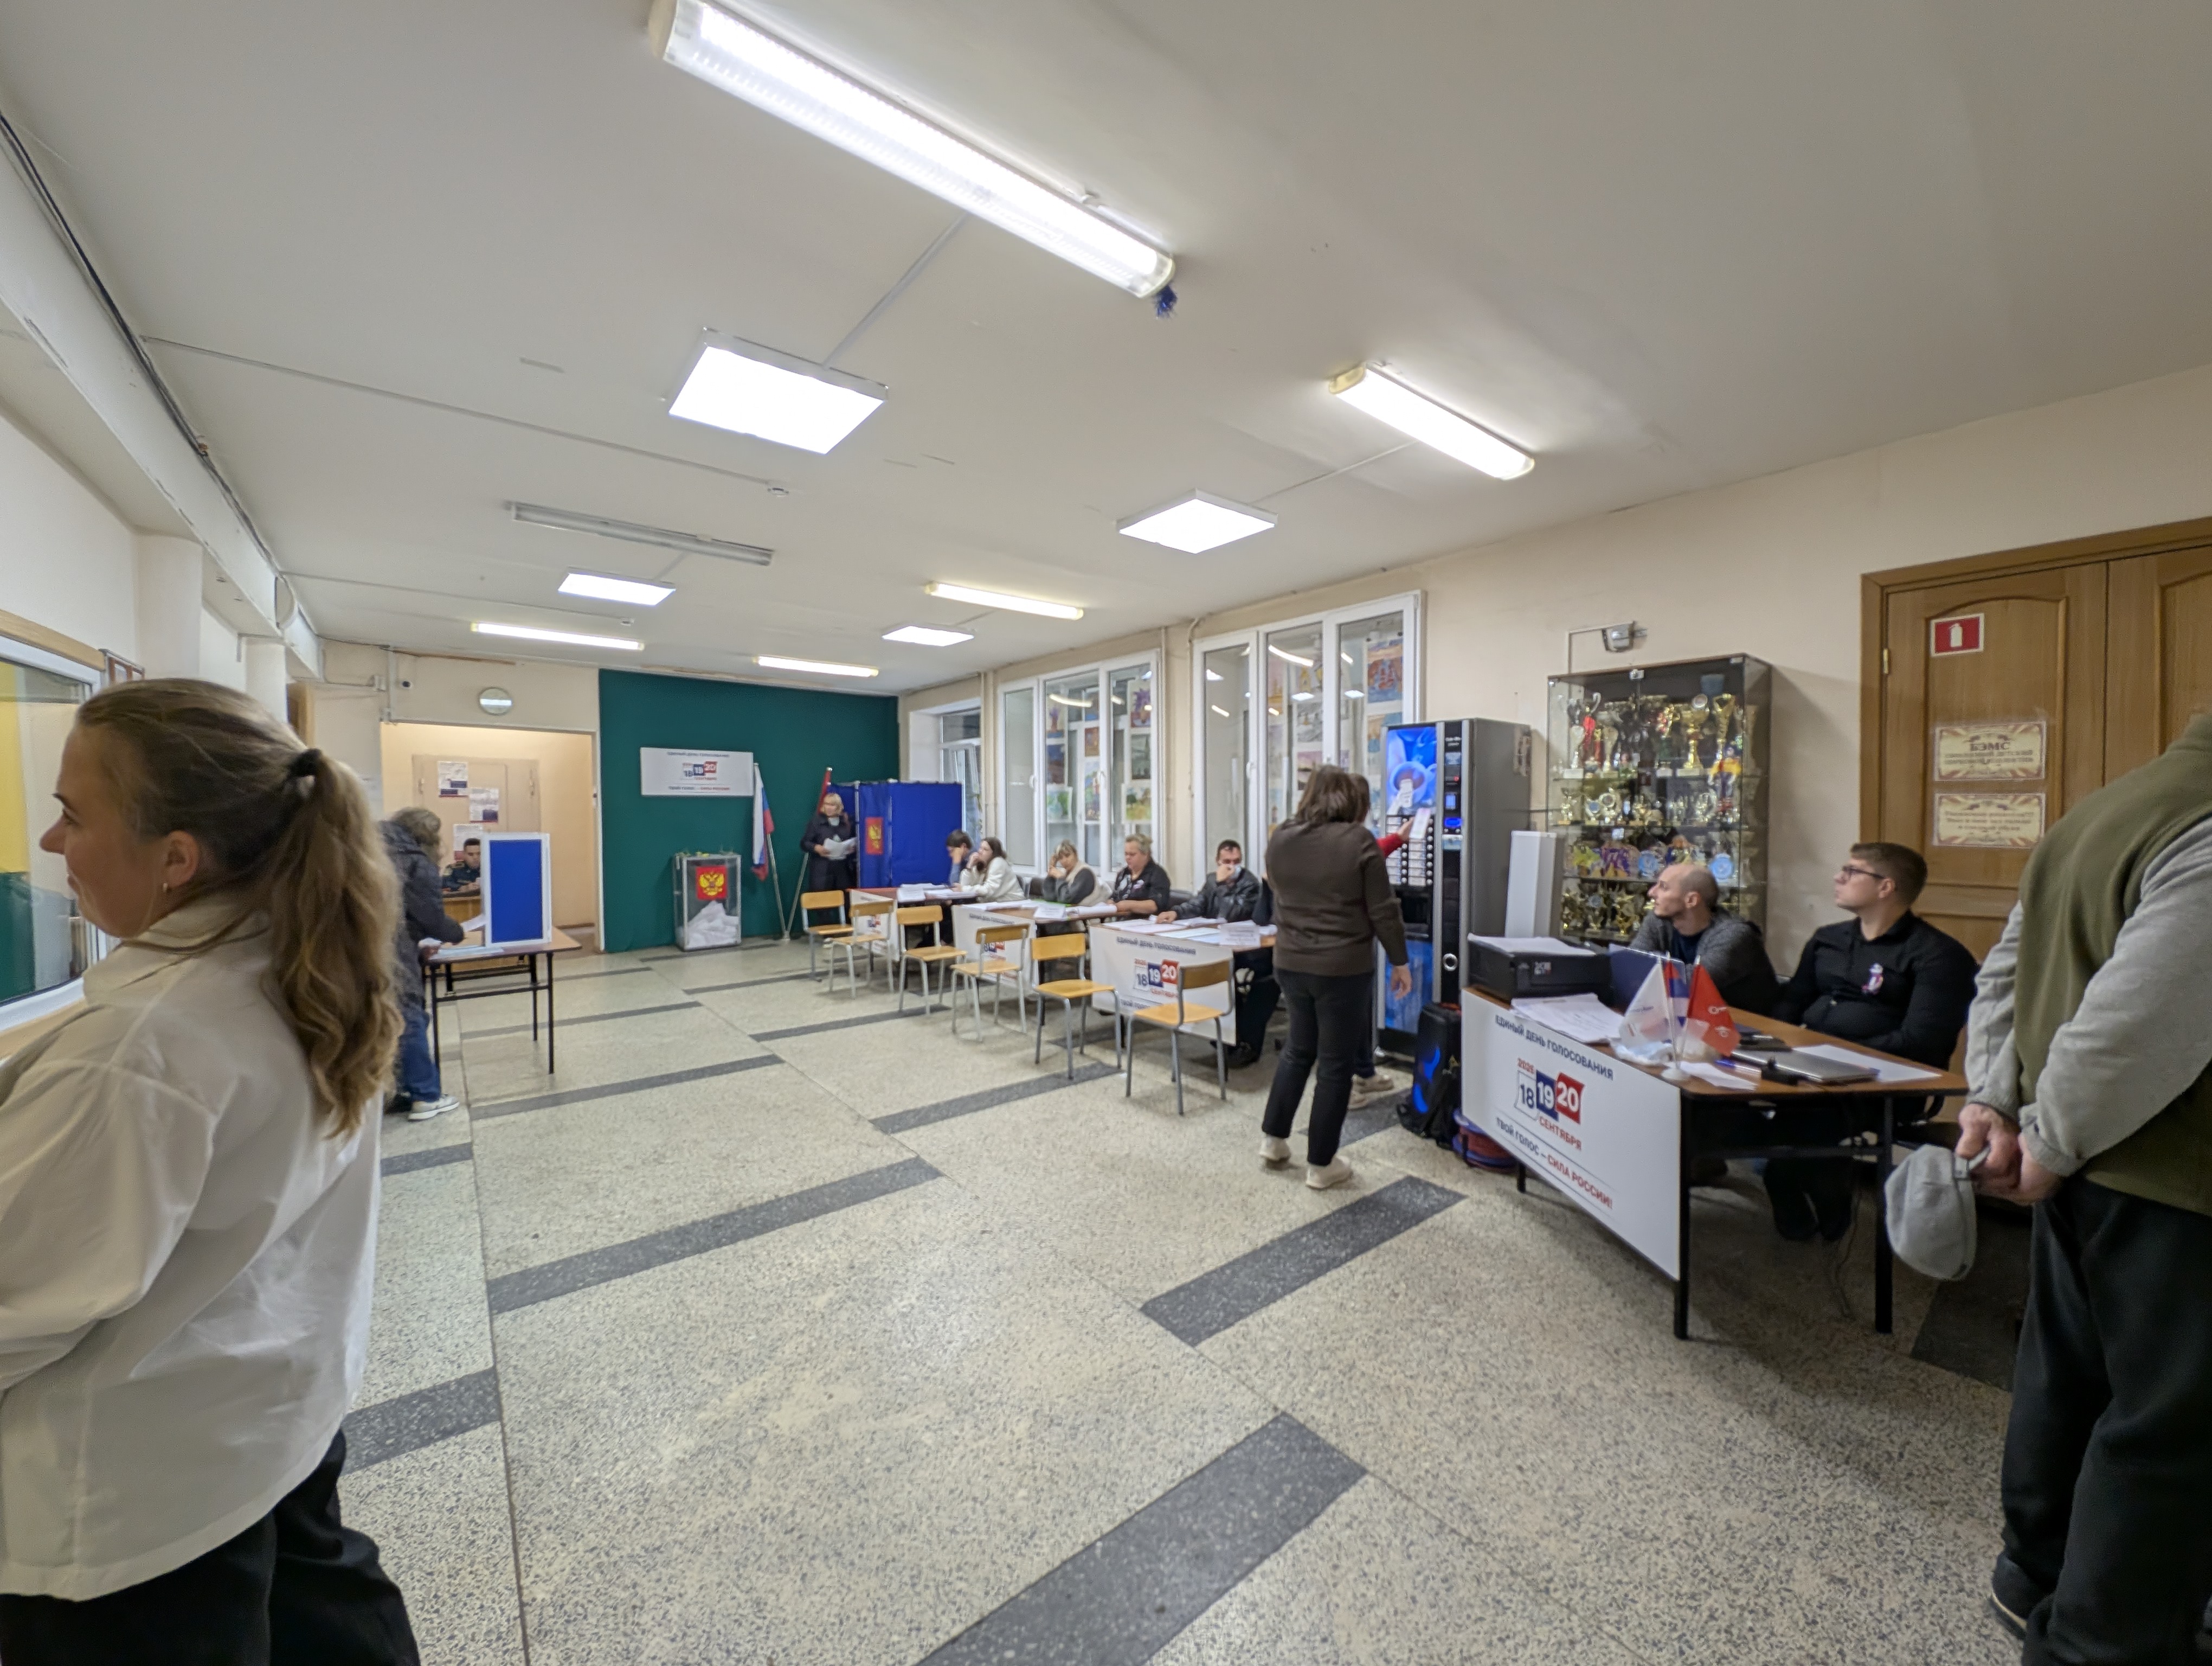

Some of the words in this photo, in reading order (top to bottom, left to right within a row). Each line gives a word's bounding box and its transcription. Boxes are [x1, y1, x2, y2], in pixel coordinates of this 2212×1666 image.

[1137, 973, 1148, 986] 18
[1148, 969, 1161, 984] 19
[1162, 964, 1178, 979] 20
[1495, 1014, 1525, 1036] ЕДИНЫЙ
[1526, 1029, 1546, 1047] ДЕНЬ
[1547, 1040, 1614, 1081] ГОЛОСОВАНИЯ
[1520, 1084, 1535, 1109] 18
[1537, 1081, 1554, 1109] 19
[1557, 1081, 1579, 1112] 20
[1539, 1116, 1582, 1152] СЕНТЯБРЯ
[1496, 1117, 1514, 1136] ТВОЙ
[1515, 1131, 1539, 1156] ГОЛОС
[1547, 1154, 1571, 1178] СИЛА
[1572, 1171, 1613, 1210] РОССИИ!
